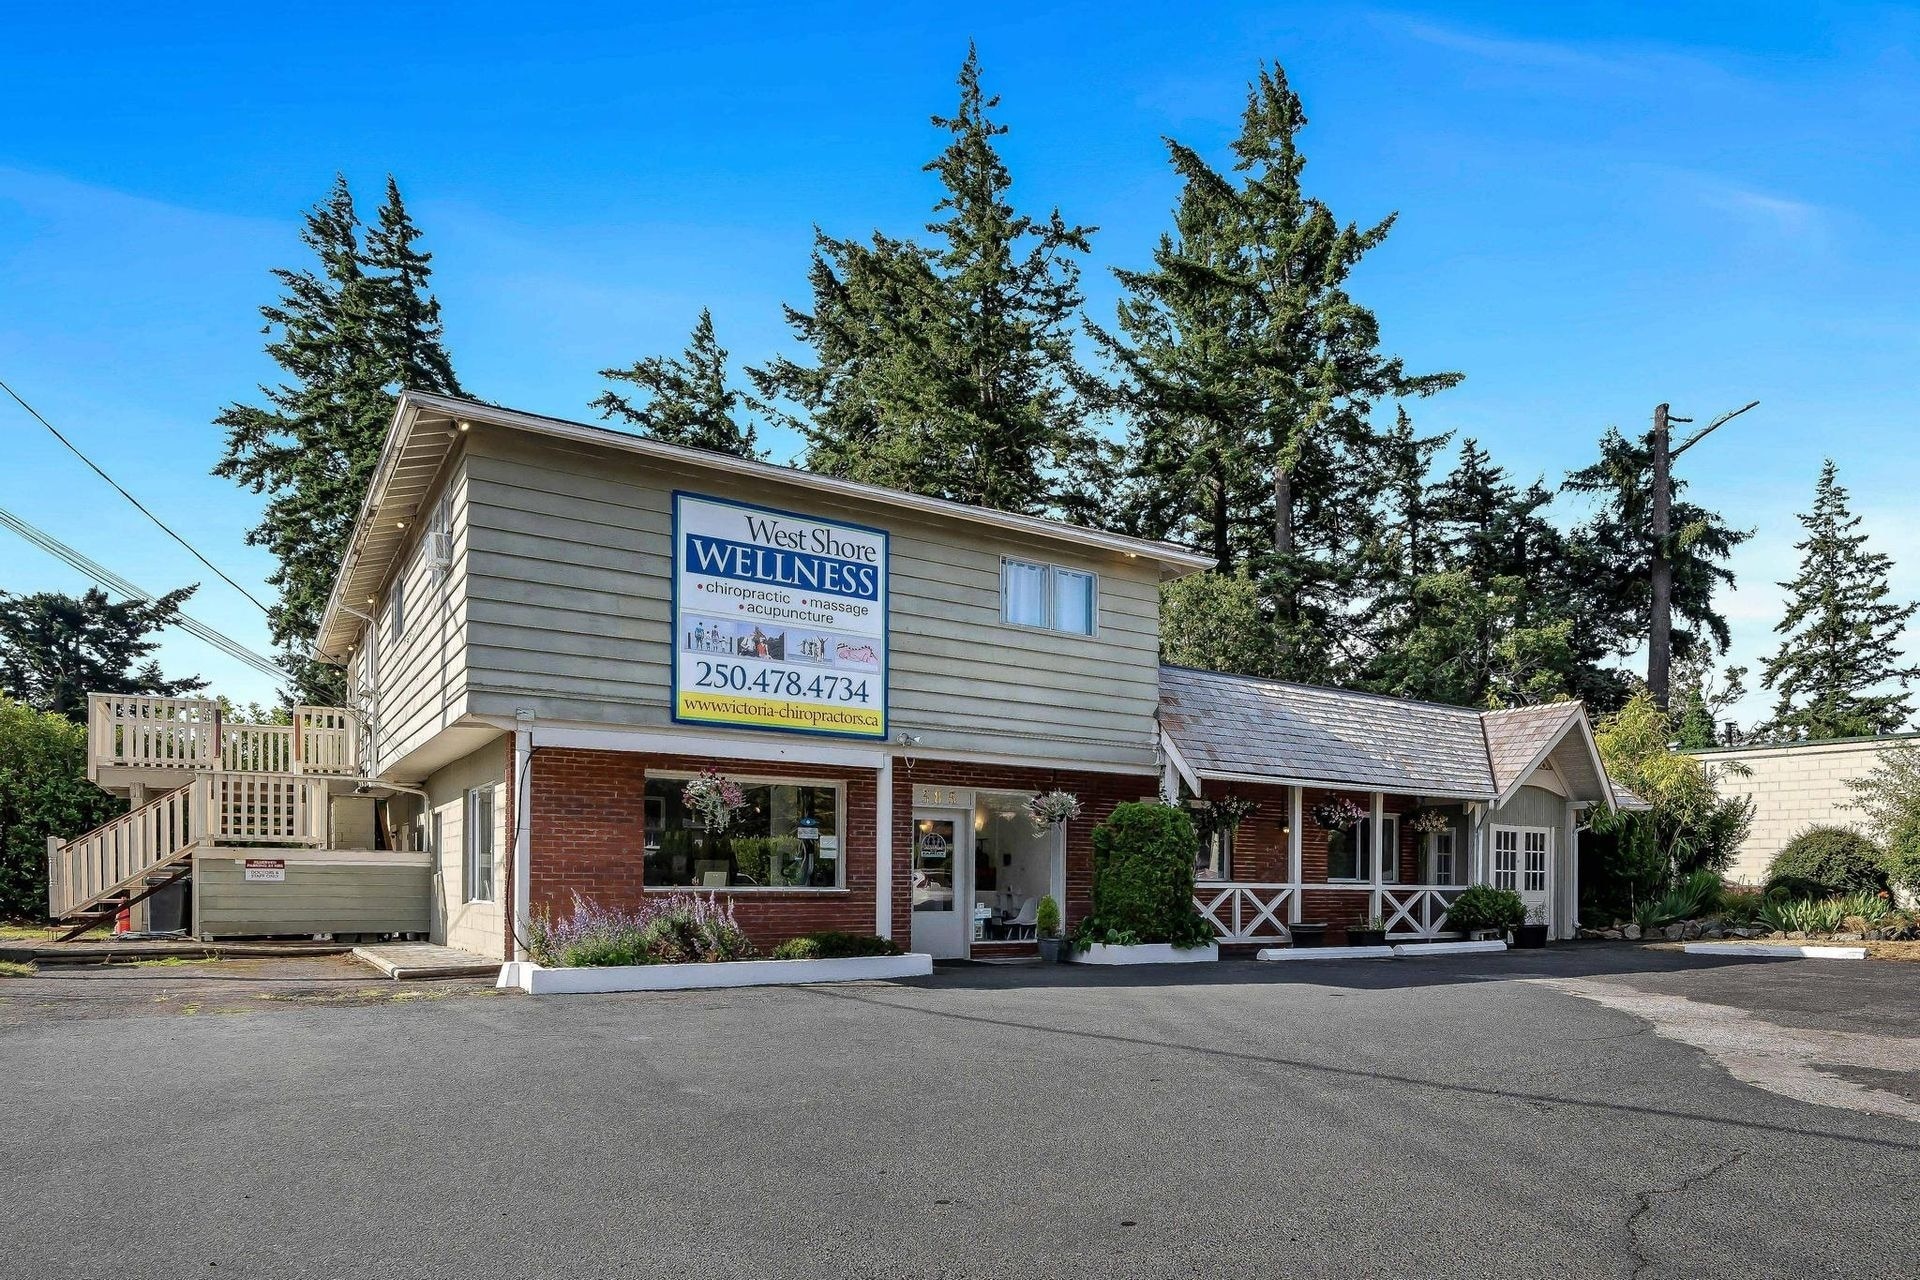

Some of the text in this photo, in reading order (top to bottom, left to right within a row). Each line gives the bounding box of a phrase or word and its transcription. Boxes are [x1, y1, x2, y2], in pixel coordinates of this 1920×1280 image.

[745, 515, 877, 563] West Shore
[692, 538, 874, 596] WELLNESS
[706, 581, 869, 616] chiropractic massage
[746, 603, 834, 624] acupuncture
[695, 661, 869, 703] 250.478.4734
[684, 699, 879, 727] www.victoria-chiropractors.ca
